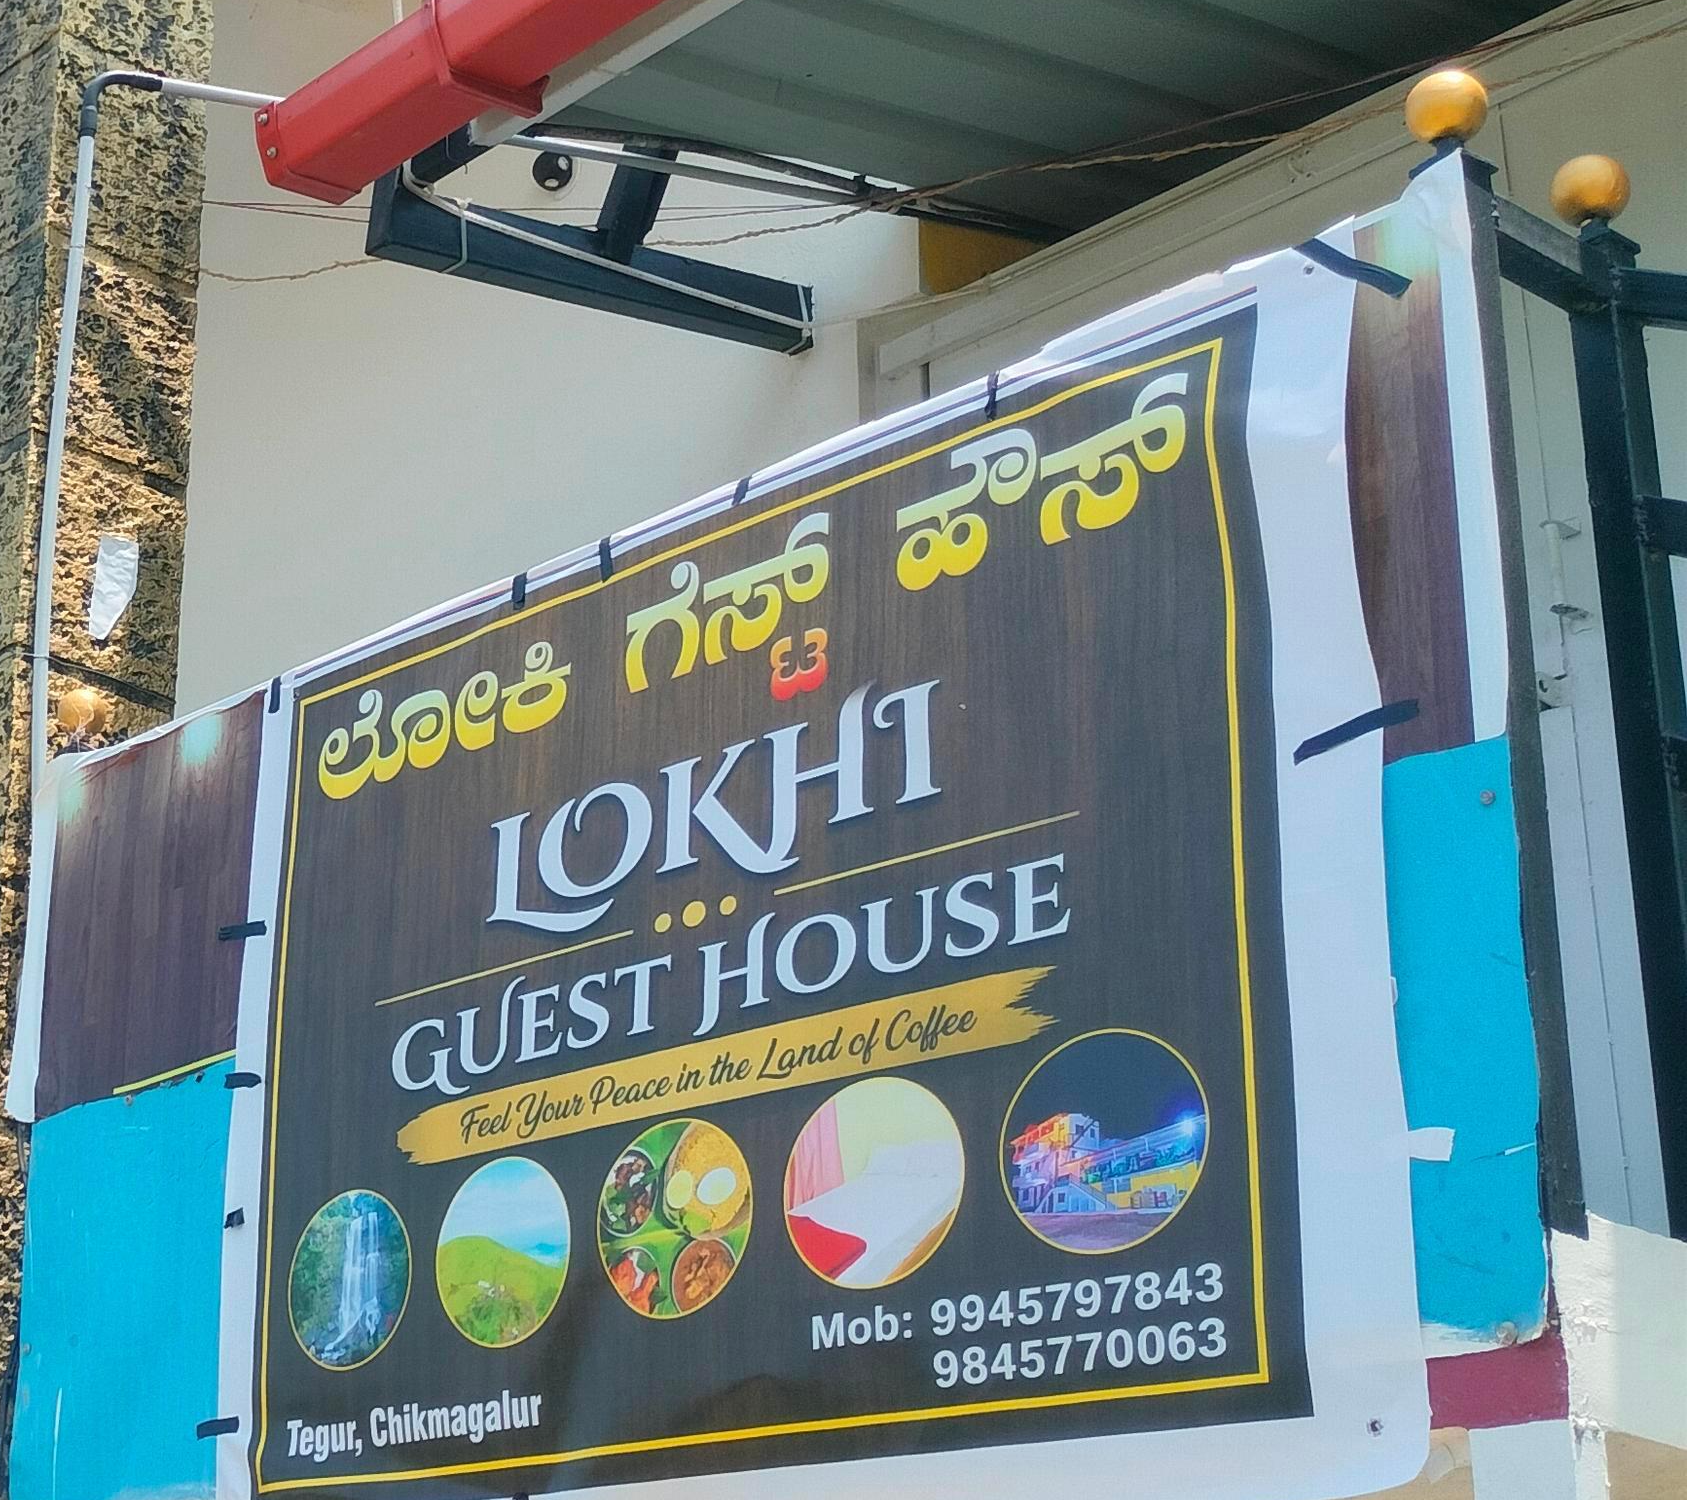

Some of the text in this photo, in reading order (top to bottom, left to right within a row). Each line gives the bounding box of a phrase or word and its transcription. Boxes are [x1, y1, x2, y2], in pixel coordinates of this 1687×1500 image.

[318, 641, 572, 800] ಲೋಕಿ
[487, 679, 941, 932] LOKHI
[391, 852, 1071, 1096] GUEST HOUSE
[461, 1004, 979, 1145] Feel Your Peace in the Land of Coffee
[812, 1262, 1224, 1351] Mob: 9945797843
[932, 1317, 1228, 1388] 9845770063
[287, 1389, 542, 1463] Tegur, Chikmagalur
